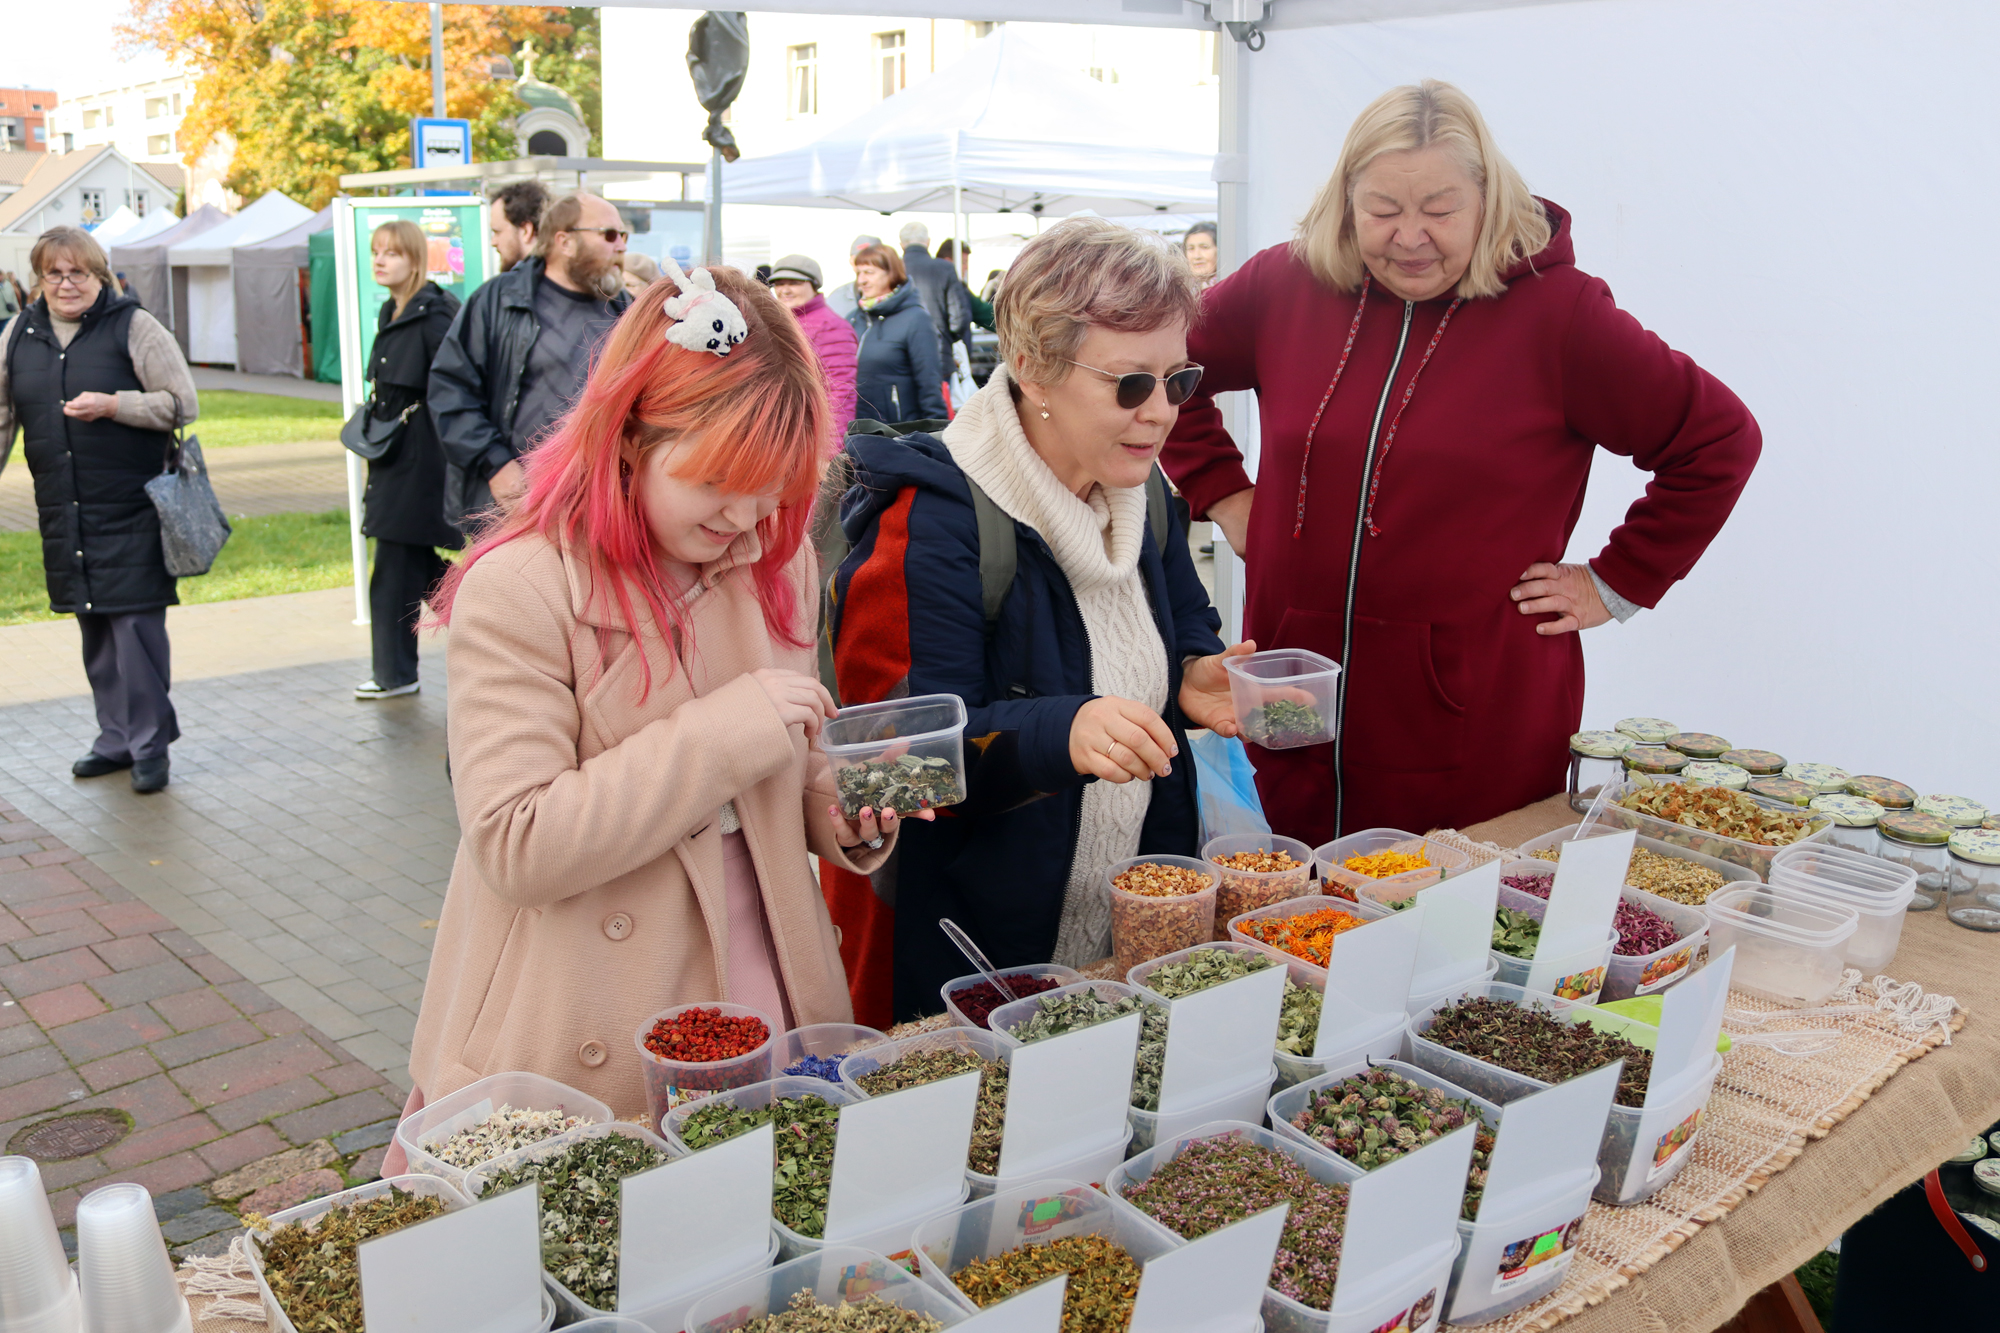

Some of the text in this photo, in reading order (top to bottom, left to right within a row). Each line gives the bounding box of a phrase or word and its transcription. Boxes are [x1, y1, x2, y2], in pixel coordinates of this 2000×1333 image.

[1026, 1224, 1050, 1234] CURVER
[1021, 1235, 1041, 1244] FRESH
[1504, 1267, 1526, 1278] CURVER
